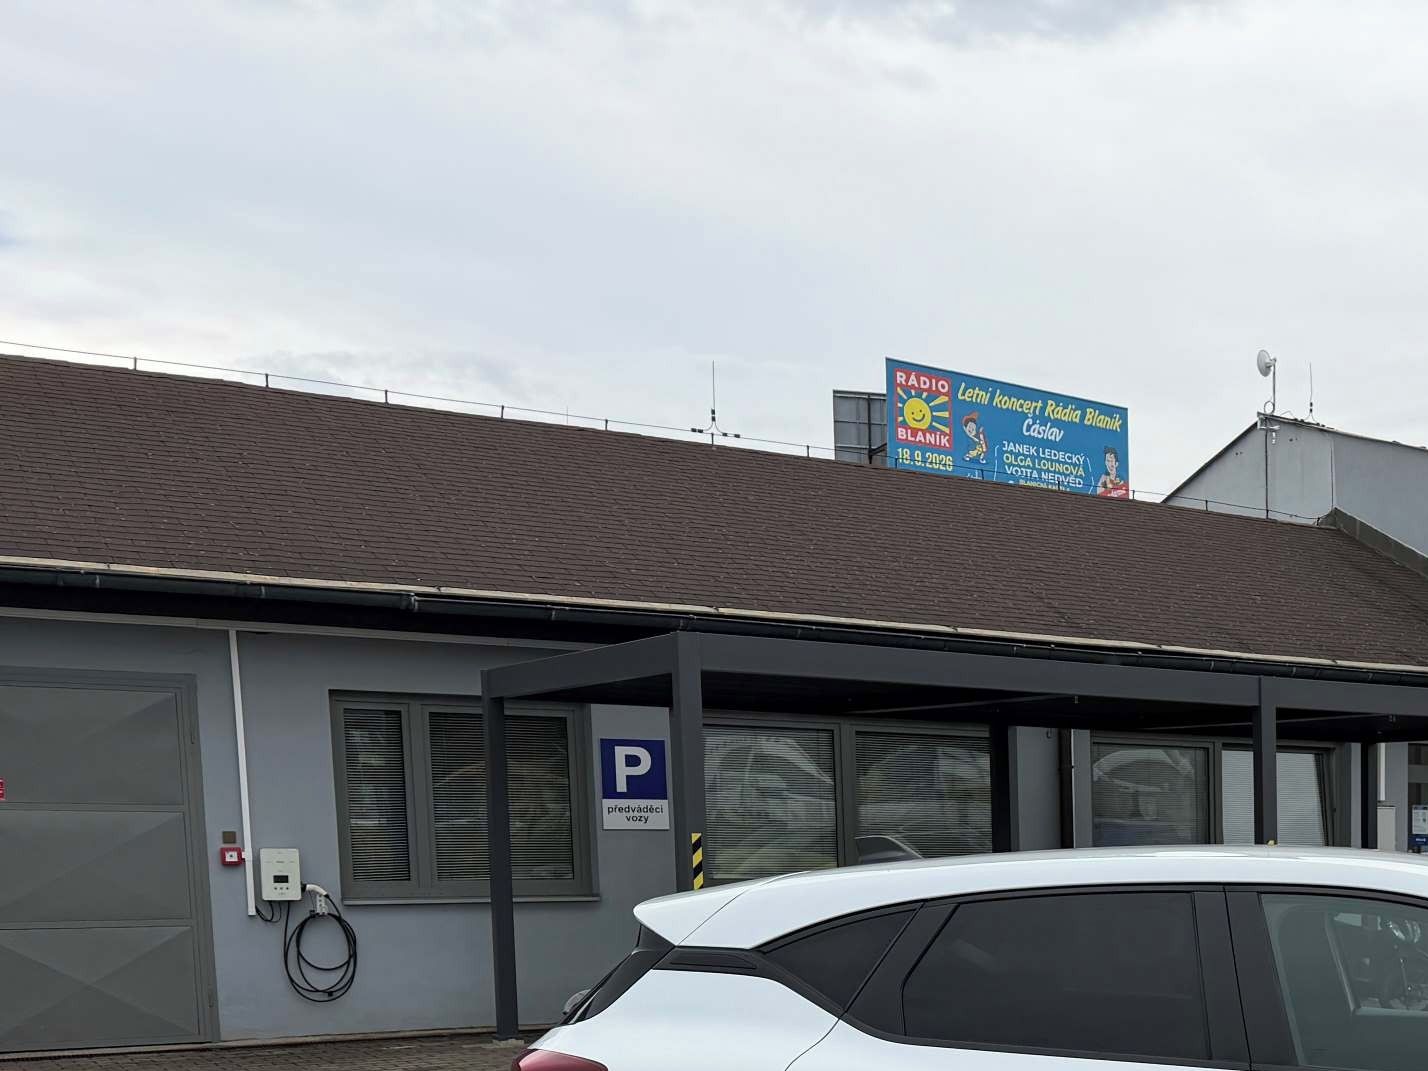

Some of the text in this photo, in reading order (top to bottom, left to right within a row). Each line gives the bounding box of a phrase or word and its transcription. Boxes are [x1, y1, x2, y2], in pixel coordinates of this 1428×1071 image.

[896, 371, 949, 393] RÁDIO
[957, 382, 1122, 432] Letní koncert Rádia Blaník
[897, 427, 950, 447] BLANÍK
[1023, 413, 1064, 442] Čáslav
[1002, 441, 1085, 465] JANEK LEDECKÝ
[1003, 453, 1085, 477] OLGA LOUNOVÁ
[1005, 465, 1038, 479] VOJTA
[1041, 471, 1083, 488] NEDVĚD
[614, 745, 652, 792] P
[625, 814, 650, 824] vozy
